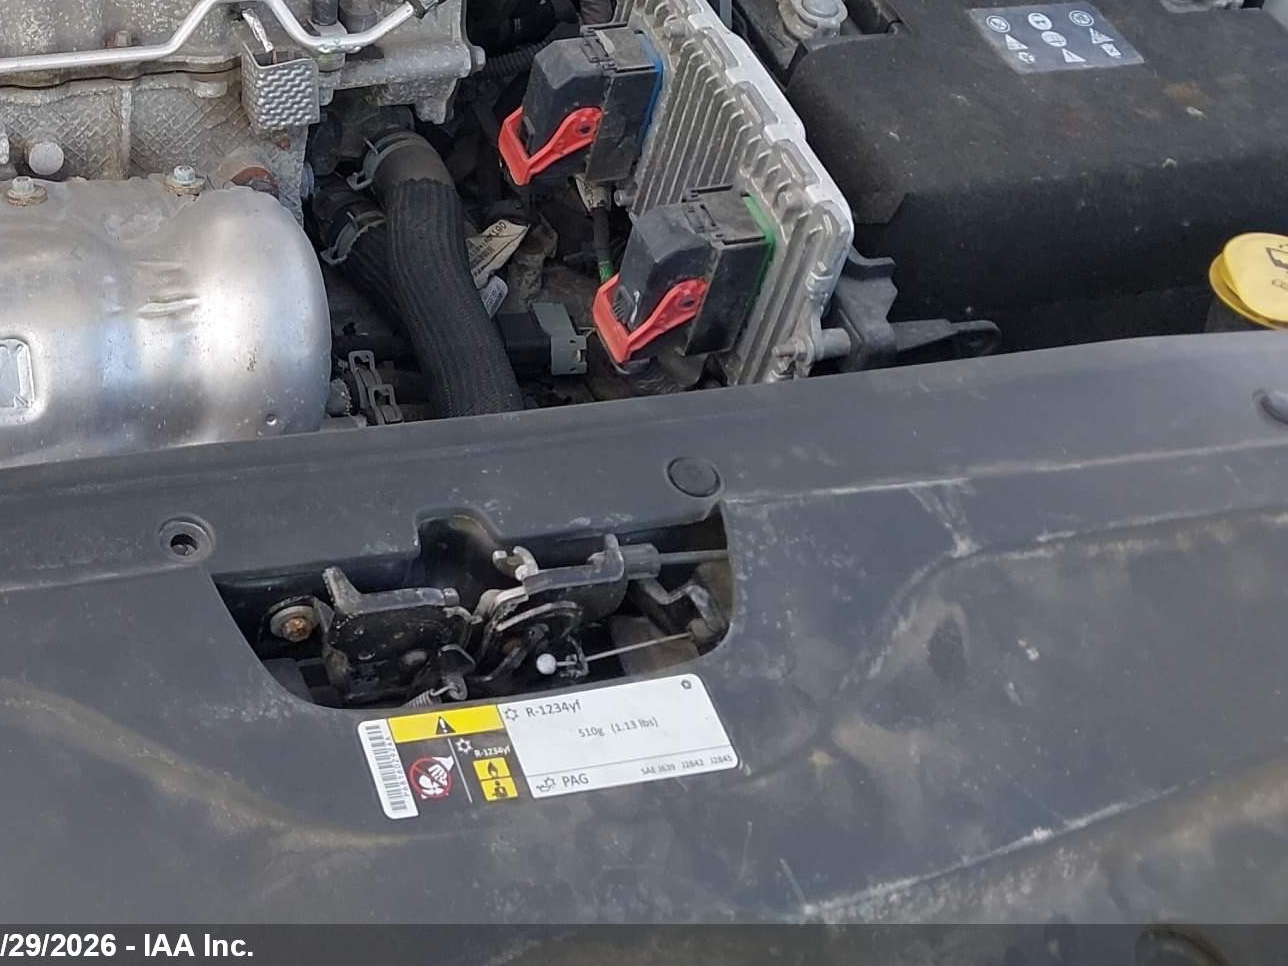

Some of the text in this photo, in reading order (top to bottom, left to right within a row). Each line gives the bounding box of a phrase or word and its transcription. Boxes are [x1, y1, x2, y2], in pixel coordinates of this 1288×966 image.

[525, 699, 582, 718] R-1234yf
[578, 726, 606, 738] 510g
[562, 773, 590, 787] PAG
